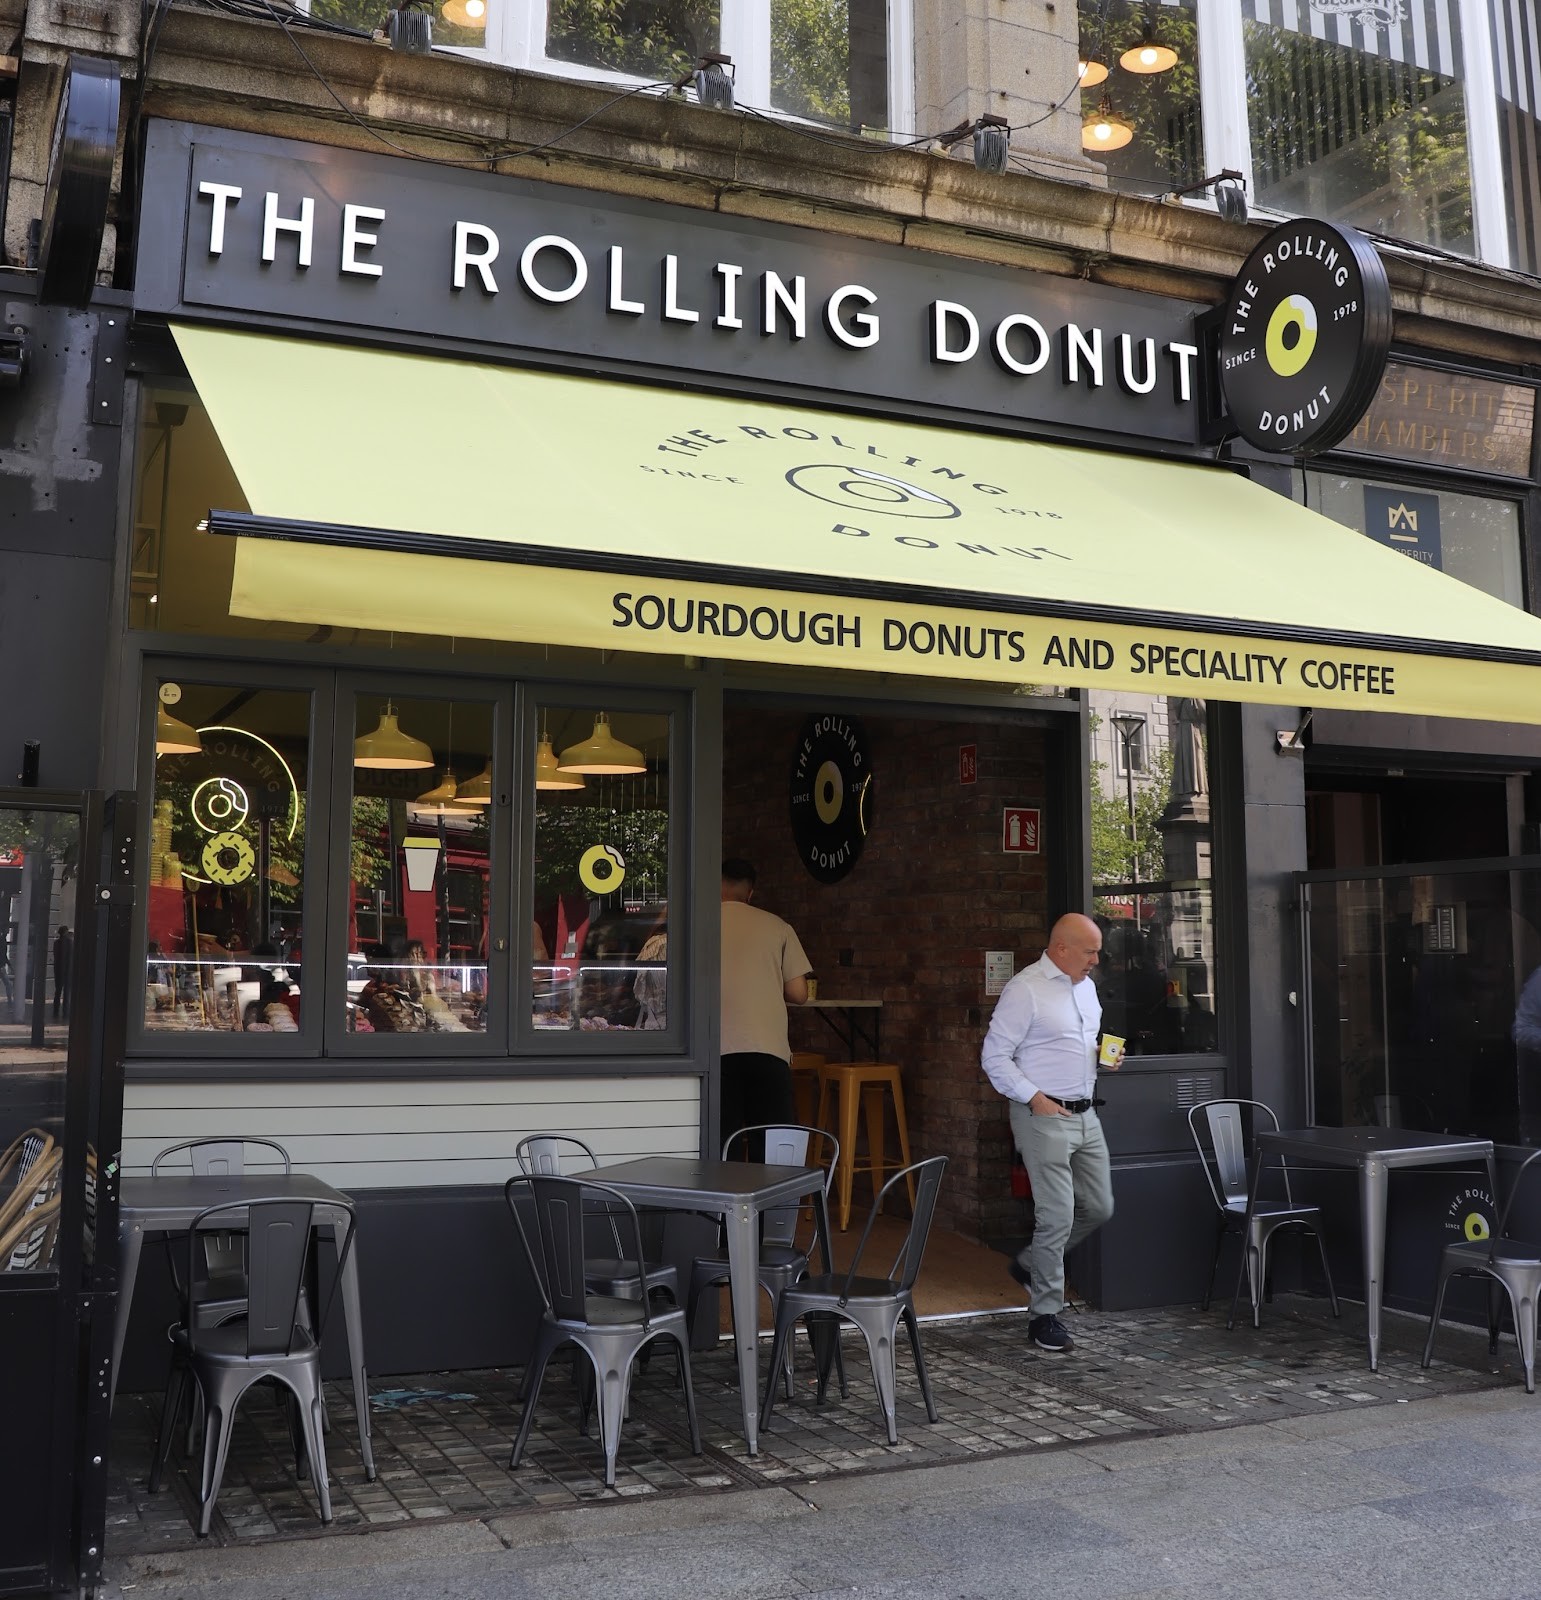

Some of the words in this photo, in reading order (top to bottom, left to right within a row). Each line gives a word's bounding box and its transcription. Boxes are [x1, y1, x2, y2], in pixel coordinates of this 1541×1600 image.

[199, 181, 386, 278] THE
[452, 220, 880, 348] ROLLING
[933, 299, 1198, 401] DONUT
[1232, 279, 1260, 335] THE
[1262, 235, 1349, 287] ROLLING
[1333, 300, 1358, 321] 1978
[1225, 348, 1257, 370] SINCE
[1258, 385, 1332, 435] DONUT
[1380, 374, 1521, 424] SPERITY
[657, 429, 729, 458] THE
[737, 425, 1009, 494] ROLLING
[1352, 415, 1498, 461] HAMBERS
[639, 465, 745, 485] SINCE
[995, 506, 1064, 520] 1978
[831, 523, 1074, 561] DONUT
[612, 592, 861, 648] SOURDOUGH
[883, 619, 1025, 662] DONUTS
[1043, 635, 1114, 670] AND
[1130, 643, 1288, 685] SPECIALITY
[1300, 660, 1395, 695] COFFEE
[201, 742, 281, 793] ROLLING
[797, 738, 812, 779] THE
[814, 716, 862, 767] ROLLING
[793, 793, 810, 804] SINCE
[811, 840, 851, 869] DONUT
[1449, 1195, 1463, 1217] THE
